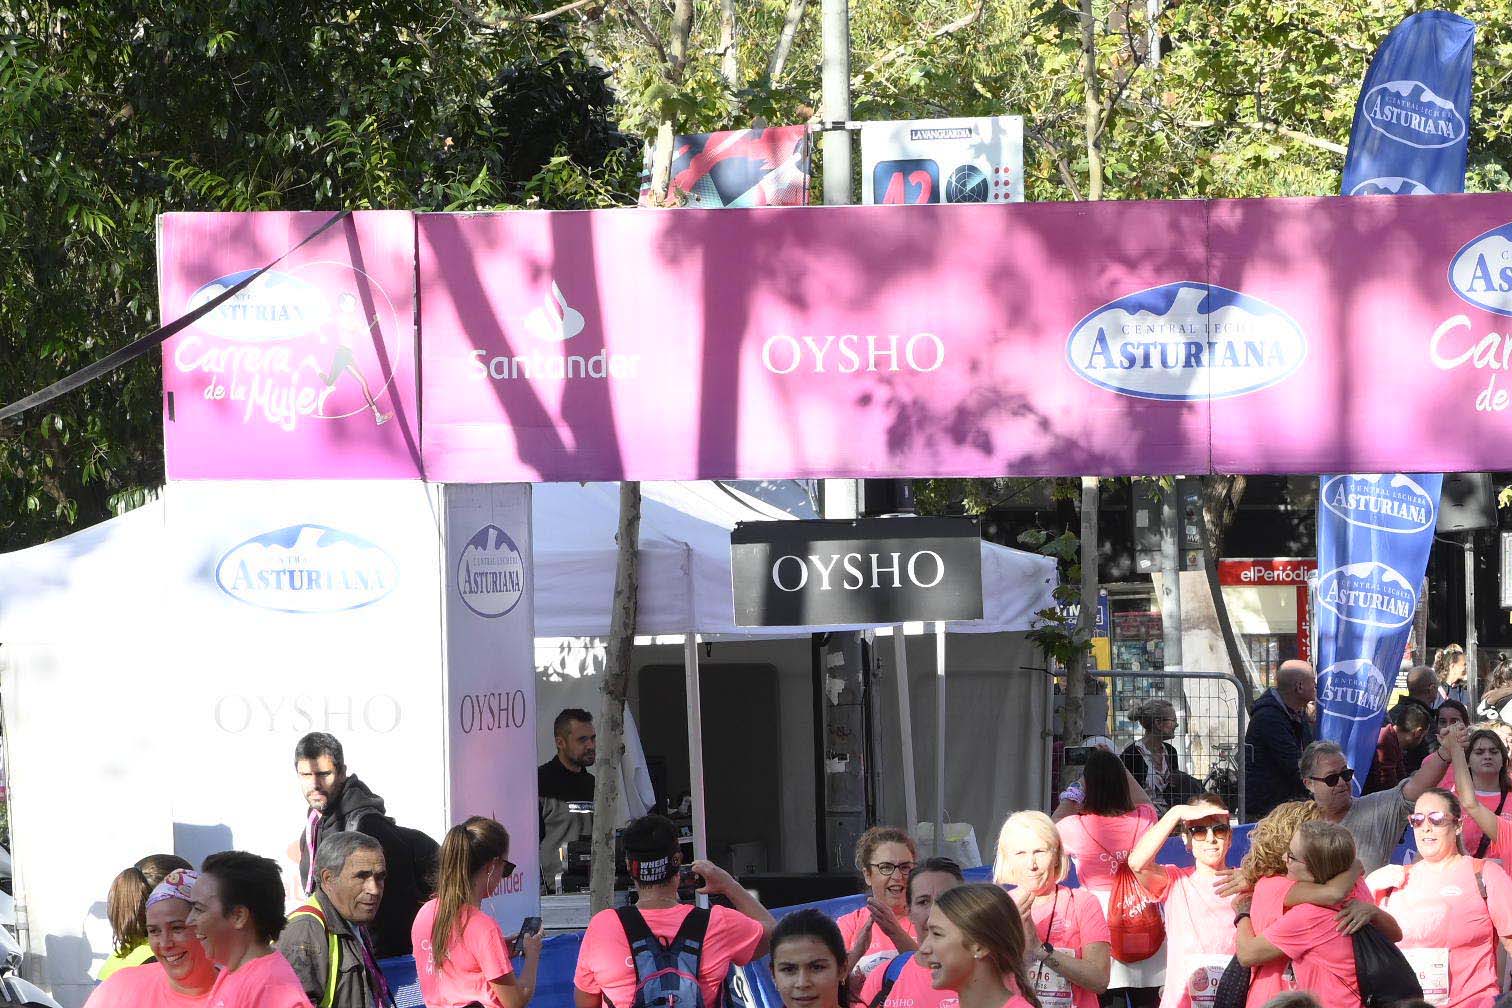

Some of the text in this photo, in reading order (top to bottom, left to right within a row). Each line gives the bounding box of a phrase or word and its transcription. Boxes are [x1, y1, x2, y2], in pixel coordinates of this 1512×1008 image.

[1370, 94, 1455, 139] ASTURIANA
[174, 336, 291, 374] Carrera
[467, 346, 641, 381] Santander
[761, 332, 945, 375] OYSHO
[1084, 326, 1287, 371] ASTURIANA
[203, 376, 226, 400] de
[230, 378, 244, 401] la
[1475, 373, 1511, 413] de
[1331, 482, 1427, 525] ASTURIANA
[230, 559, 386, 592] ASTURIANA
[462, 558, 522, 595] ASTURIANA
[772, 550, 946, 593] OYSHO
[1327, 580, 1410, 618] ASTURIANA
[214, 691, 403, 735] OYSHO
[460, 689, 527, 735] OYSHO
[640, 856, 669, 869] WHERE
